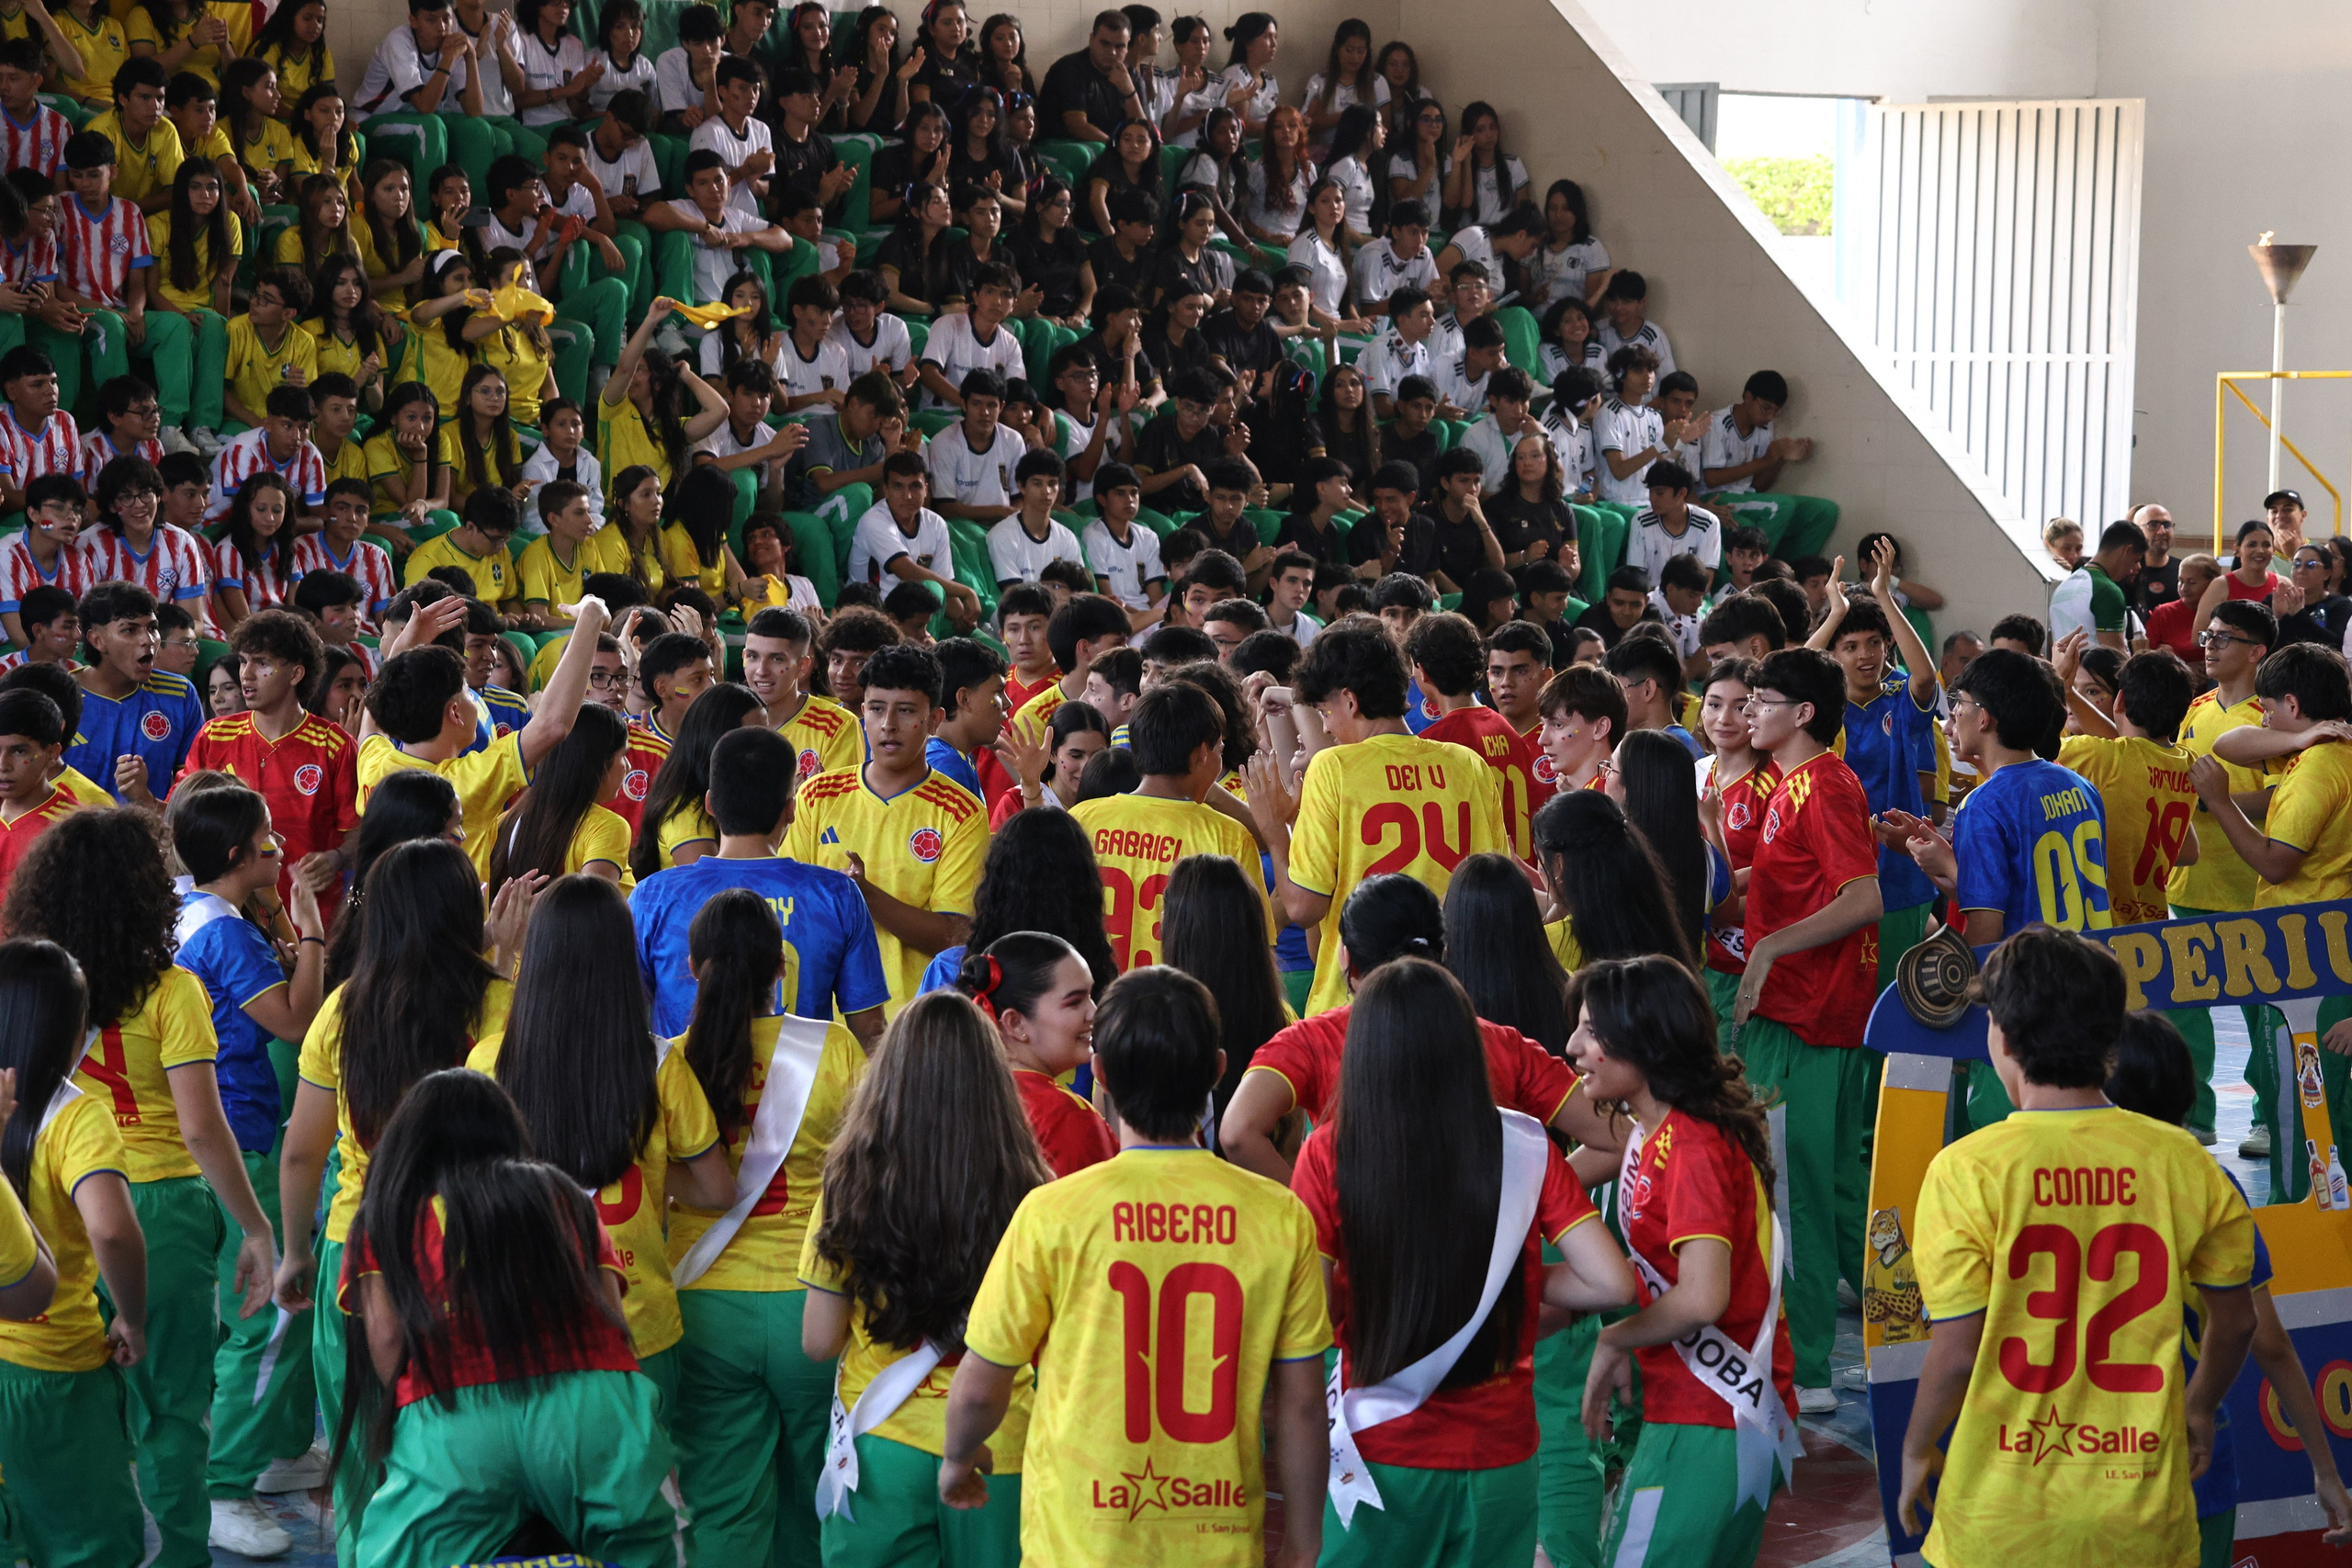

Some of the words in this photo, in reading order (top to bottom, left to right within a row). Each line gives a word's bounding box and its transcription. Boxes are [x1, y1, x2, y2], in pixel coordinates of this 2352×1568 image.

[1386, 764, 1421, 792] DEI
[2147, 765, 2197, 794] SAMUE
[2040, 786, 2088, 822] JOHAN
[2132, 795, 2190, 893] 19
[2033, 1167, 2137, 1208] CONDE
[1113, 1201, 1238, 1245] RIBERO
[1998, 1224, 2169, 1393] 32
[1108, 1259, 1244, 1445] 10
[1998, 1424, 2032, 1452] La
[2077, 1423, 2160, 1453] Salle
[1093, 1479, 1128, 1510] La
[1170, 1475, 1247, 1508] Salle
